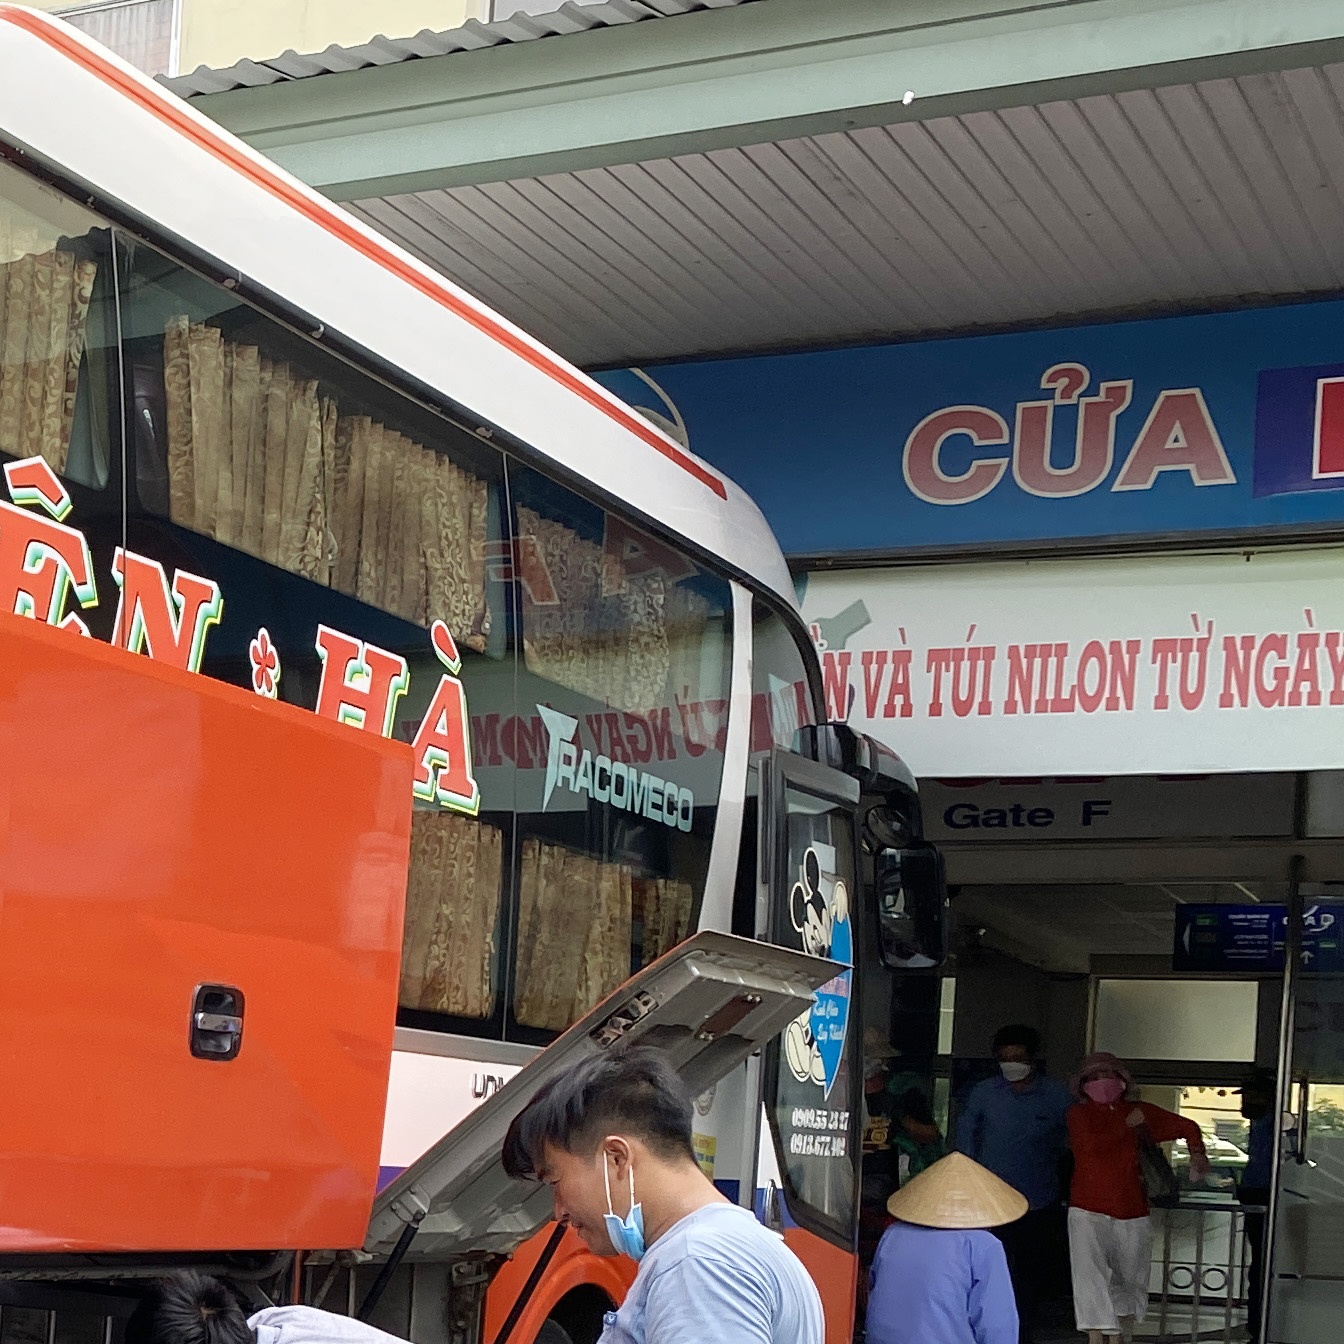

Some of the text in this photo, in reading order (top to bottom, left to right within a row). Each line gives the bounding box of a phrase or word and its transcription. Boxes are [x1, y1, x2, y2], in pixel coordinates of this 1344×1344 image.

[902, 362, 1237, 506] CỬA
[315, 618, 481, 816] HÀ
[861, 627, 914, 719] VÀ
[926, 623, 997, 718] TÚI
[1004, 639, 1142, 715] NILON
[1151, 613, 1214, 712] TỪ
[1218, 608, 1344, 710] NGÀY
[535, 703, 694, 833] TRACOMECO
[943, 799, 1113, 830] Gate F
